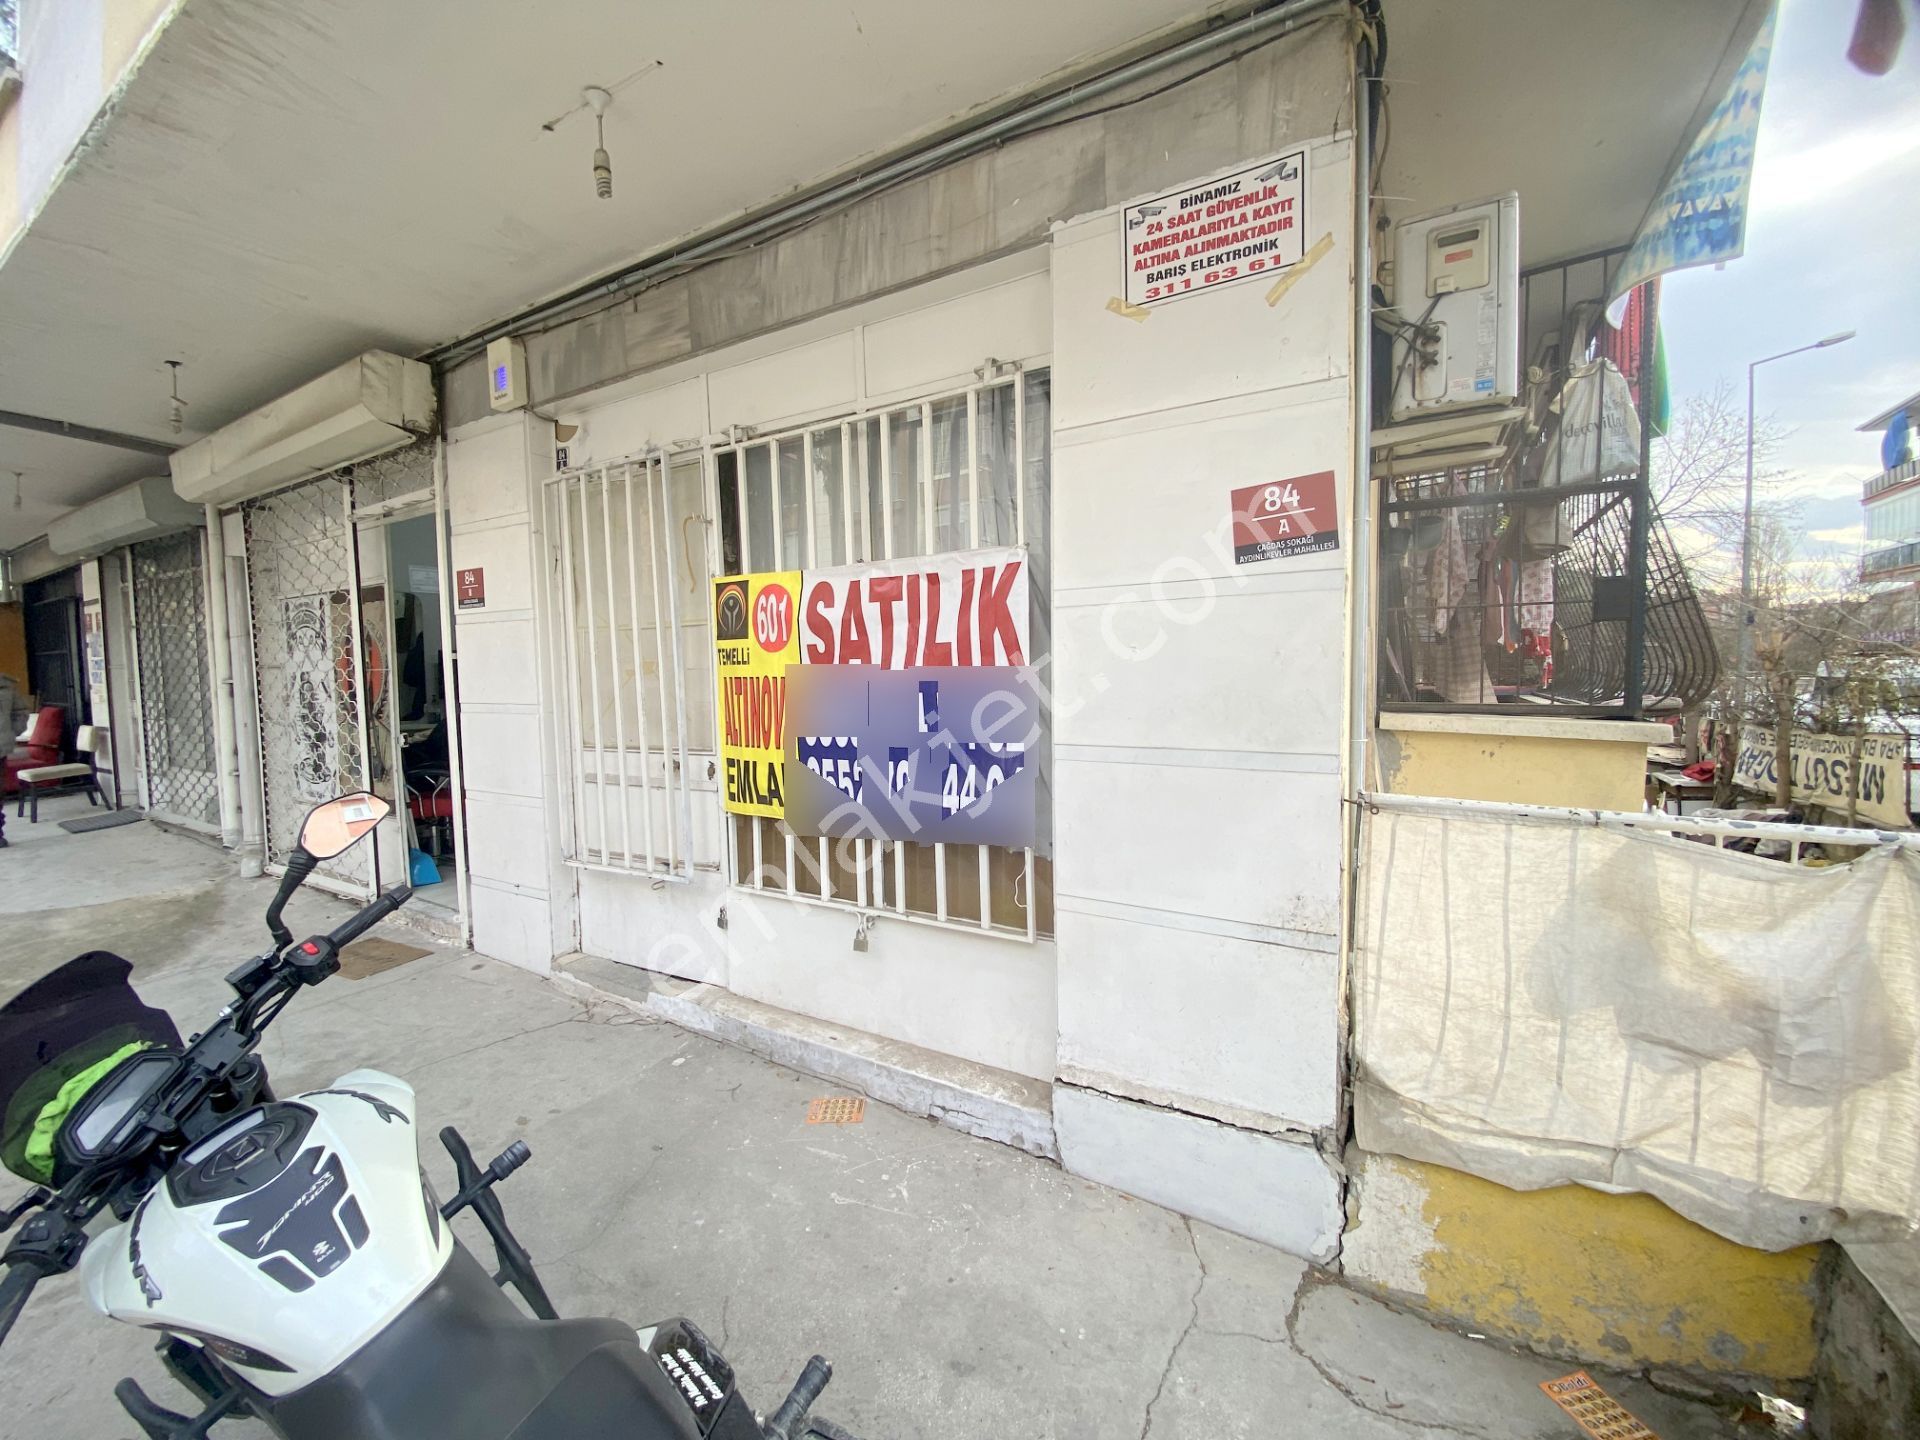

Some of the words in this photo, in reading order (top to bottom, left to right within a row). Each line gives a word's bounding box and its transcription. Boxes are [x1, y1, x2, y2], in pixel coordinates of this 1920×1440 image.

[1146, 220, 1164, 235] 24
[1167, 209, 1202, 230] SAAT
[1206, 184, 1279, 217] GÜVENLİK
[1180, 181, 1241, 209] BİNAMIZ
[1133, 210, 1248, 256] KAMERALARIYLA
[1252, 197, 1295, 221] KAYIT
[1134, 251, 1180, 272] ALTINA
[1184, 216, 1293, 258] ALINMAKTADIR
[1146, 264, 1187, 284] BARIŞ
[1191, 238, 1279, 272] ELEKTRONİK
[1204, 266, 1238, 283] 63
[1249, 254, 1281, 271] 61
[1264, 483, 1300, 511] 84
[1257, 541, 1285, 552] ÇAĞDAŞ
[1286, 535, 1314, 547] SOKAĞI
[1279, 519, 1290, 534] A
[1239, 547, 1292, 563] AYDINLIKEVLER
[1293, 540, 1335, 555] MAHALLESİ
[464, 571, 475, 585] 84
[757, 593, 788, 644] 601
[806, 561, 1024, 670] SATILIK
[724, 675, 785, 751] ALTINOV
[726, 757, 784, 808] EMLA
[305, 1175, 334, 1206] 400
